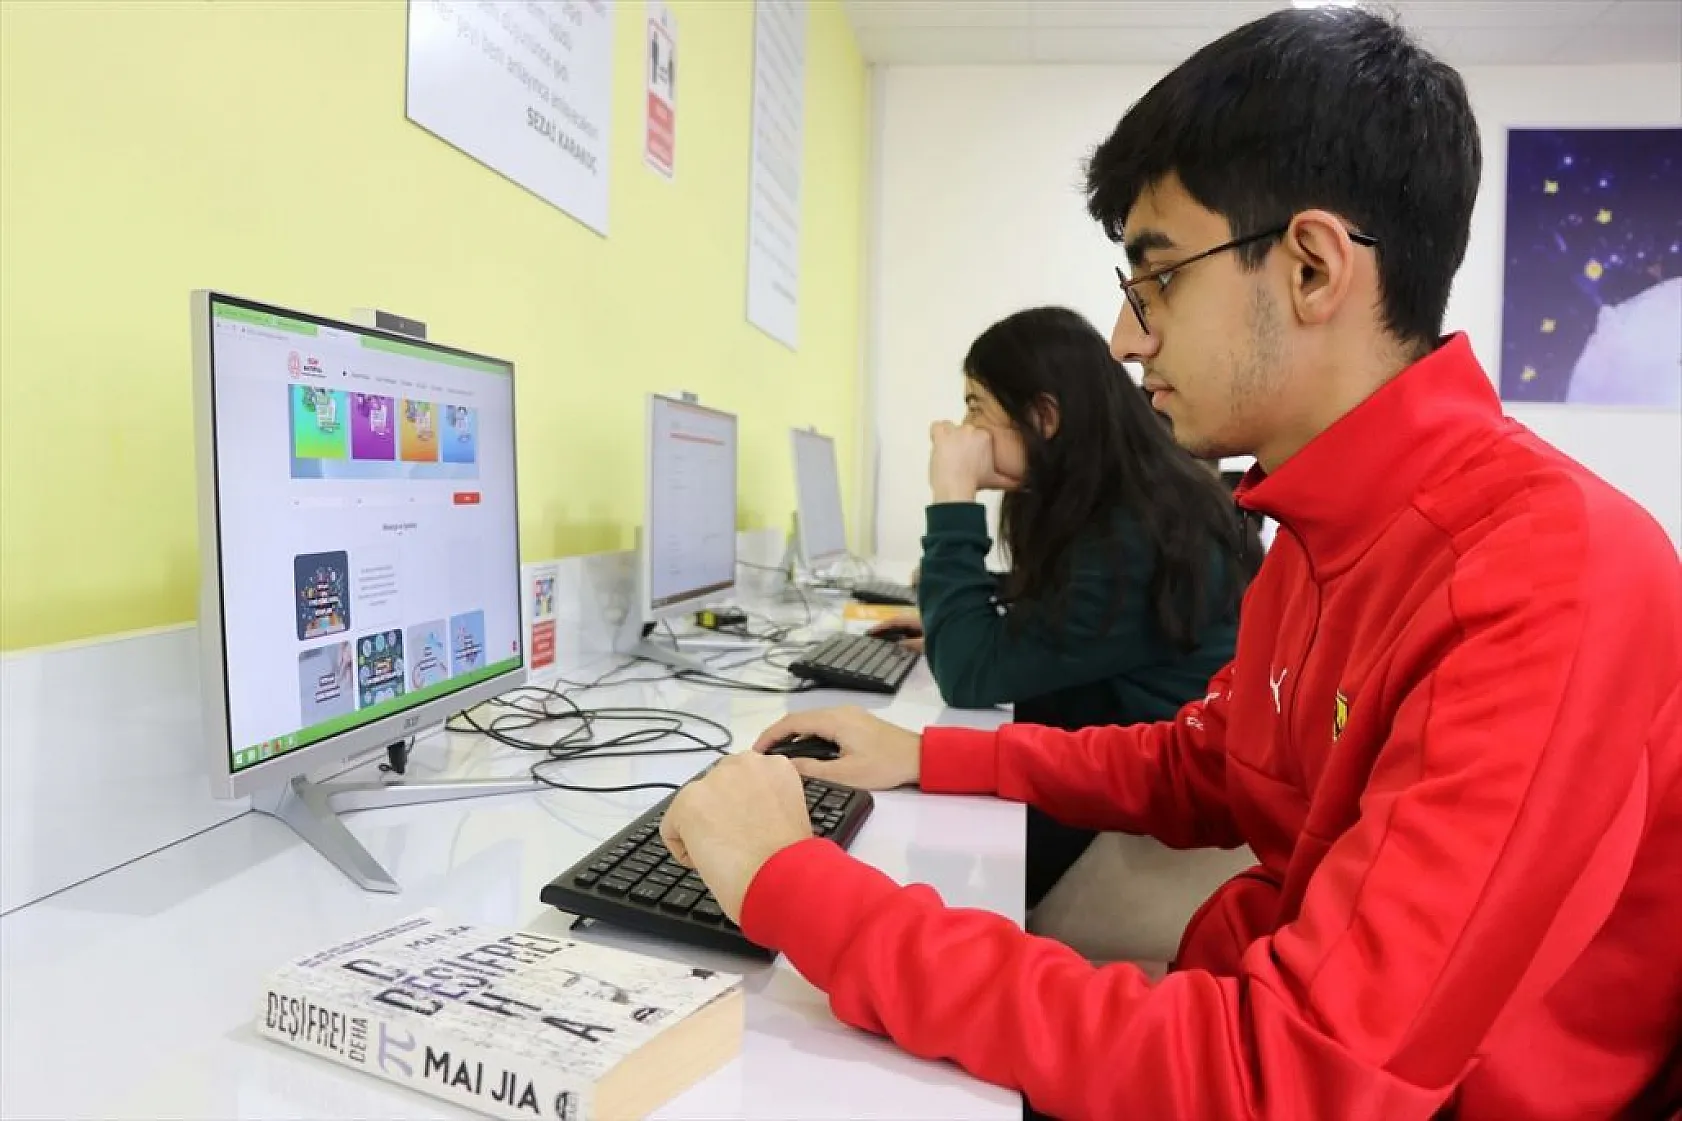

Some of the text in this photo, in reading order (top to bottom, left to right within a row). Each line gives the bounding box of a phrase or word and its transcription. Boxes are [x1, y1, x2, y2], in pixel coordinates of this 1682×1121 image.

[266, 990, 347, 1055] DEŞİFRE!
[348, 1017, 368, 1063] DEHA
[424, 1045, 483, 1096] MAI
[491, 1069, 541, 1115] JIA
